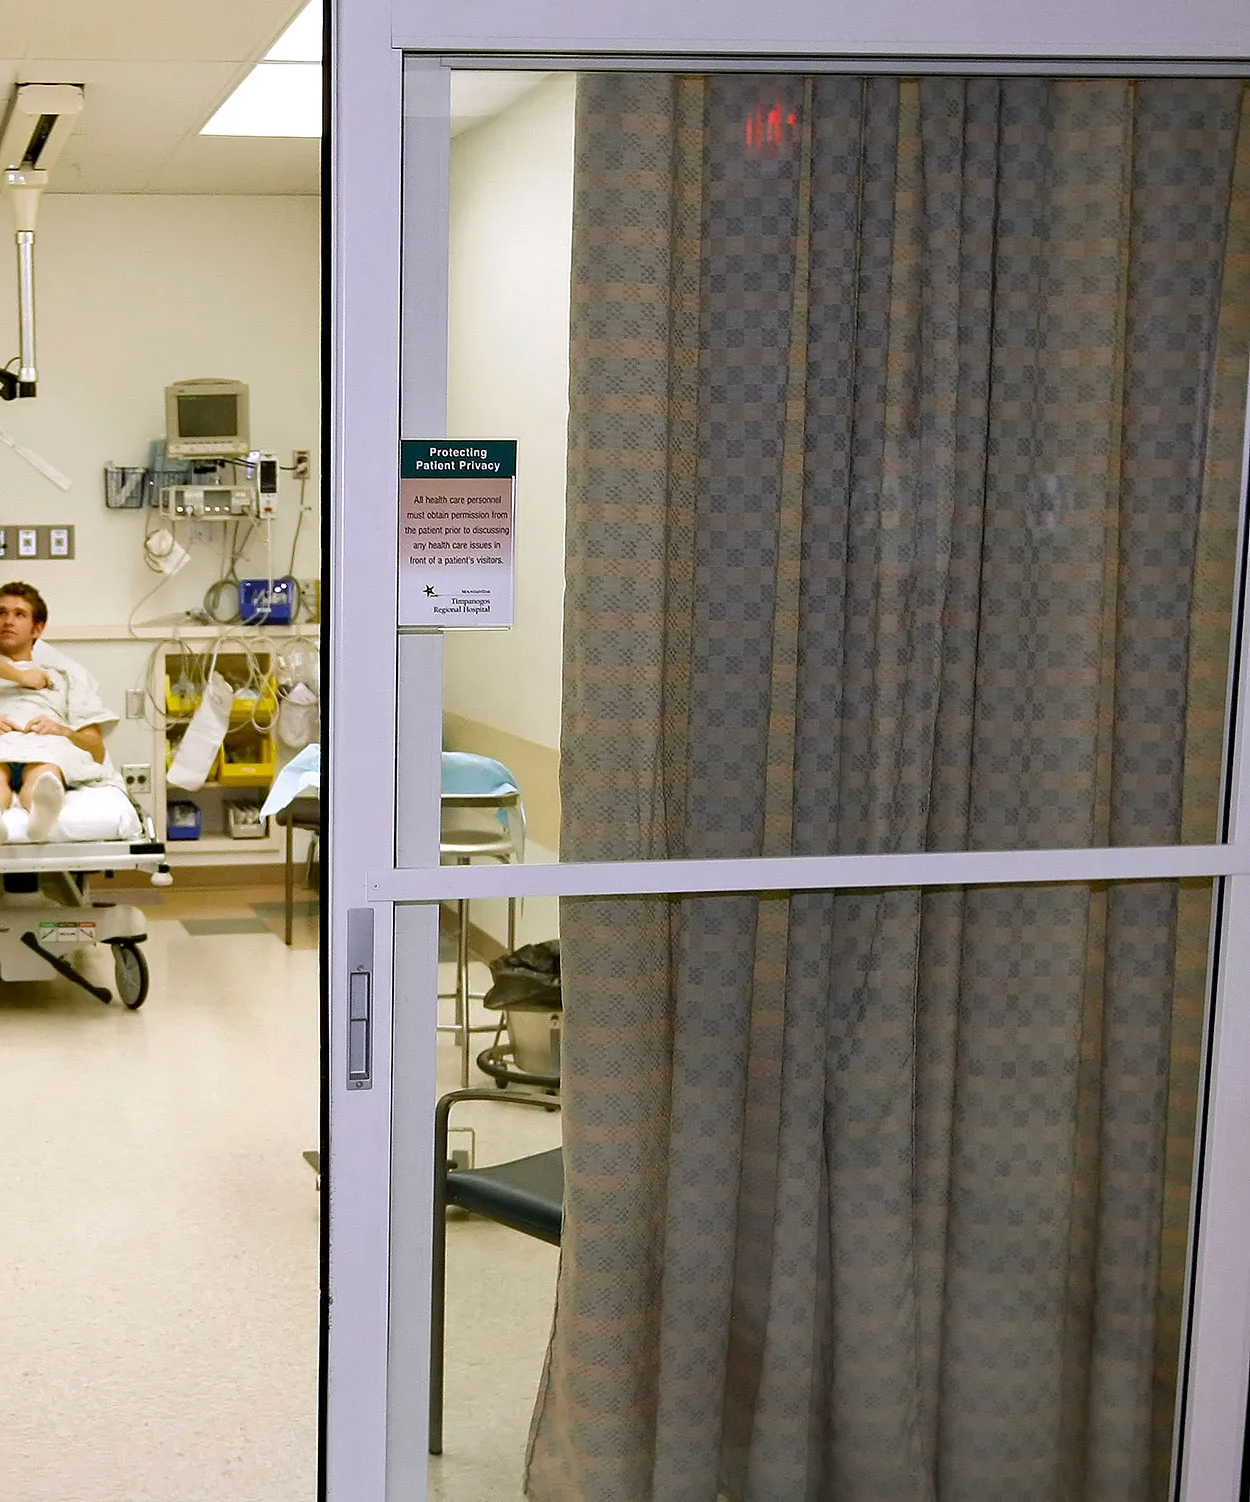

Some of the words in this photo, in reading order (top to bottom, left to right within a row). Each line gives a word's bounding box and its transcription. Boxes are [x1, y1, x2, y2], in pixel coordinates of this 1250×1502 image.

[429, 447, 488, 459] Protecting
[416, 460, 455, 470] Patient
[459, 460, 501, 472] Privacy
[413, 495, 424, 504] All
[425, 495, 448, 504] health
[467, 495, 502, 505] personnel
[407, 511, 425, 519] must
[427, 511, 449, 519] obtain
[451, 511, 490, 520] permission
[491, 511, 508, 519] from
[404, 526, 416, 534] the
[418, 526, 443, 536] patient
[444, 526, 461, 536] prior
[463, 526, 471, 534] to
[472, 526, 510, 535] discussing
[413, 542, 426, 551] any
[428, 541, 450, 549] health
[469, 541, 492, 549] issues
[493, 541, 501, 549] in
[409, 556, 426, 564] front
[428, 556, 436, 564] of
[444, 556, 475, 566] patient's
[476, 556, 503, 564] visitors.
[433, 606, 462, 614] Regional
[463, 605, 491, 615] Hospital
